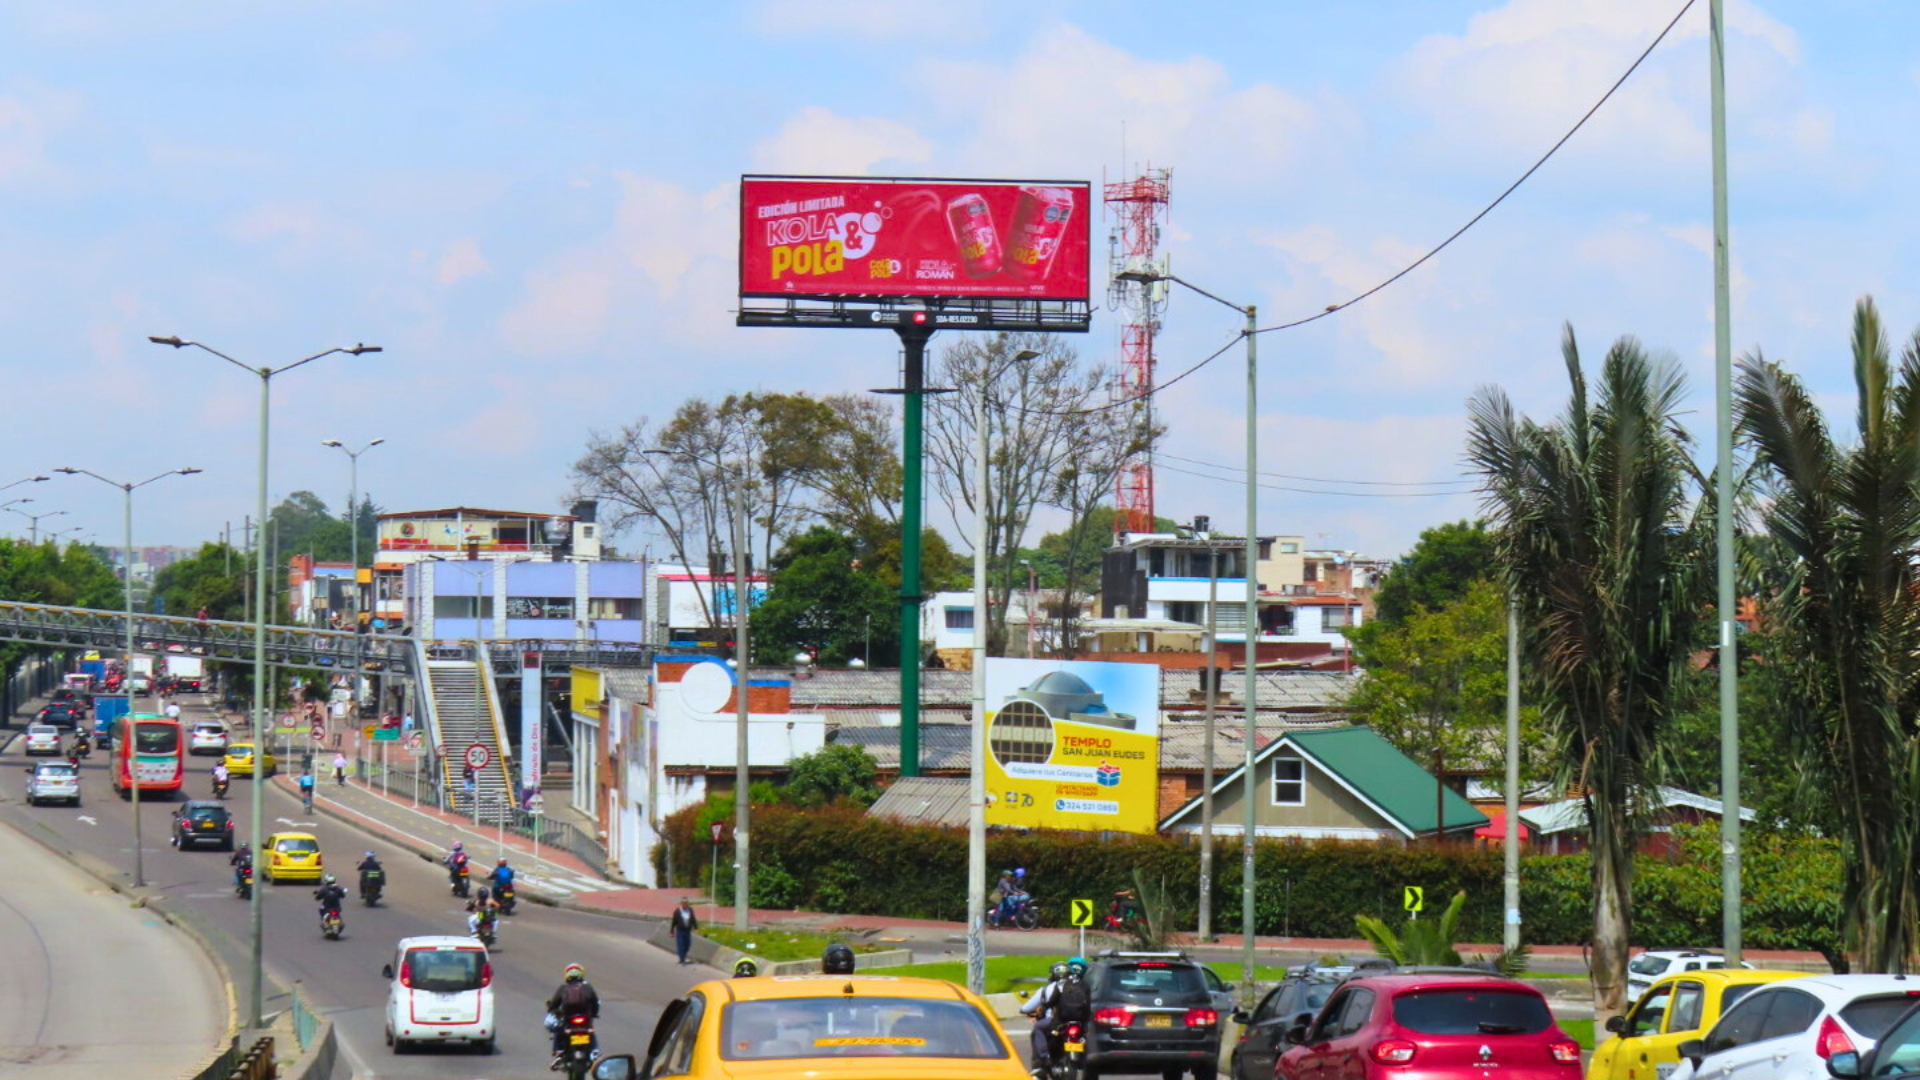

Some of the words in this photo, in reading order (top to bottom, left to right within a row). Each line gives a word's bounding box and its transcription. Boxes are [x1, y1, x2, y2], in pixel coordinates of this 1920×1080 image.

[758, 201, 797, 219] EDICIÓN
[800, 196, 845, 213] LIMITADA
[768, 213, 840, 246] KOLA
[1063, 736, 1111, 748] TEMPLO
[470, 751, 486, 763] 50
[1063, 747, 1083, 756] SAN
[1085, 748, 1111, 758] JUAN
[1113, 750, 1145, 759] EUDES
